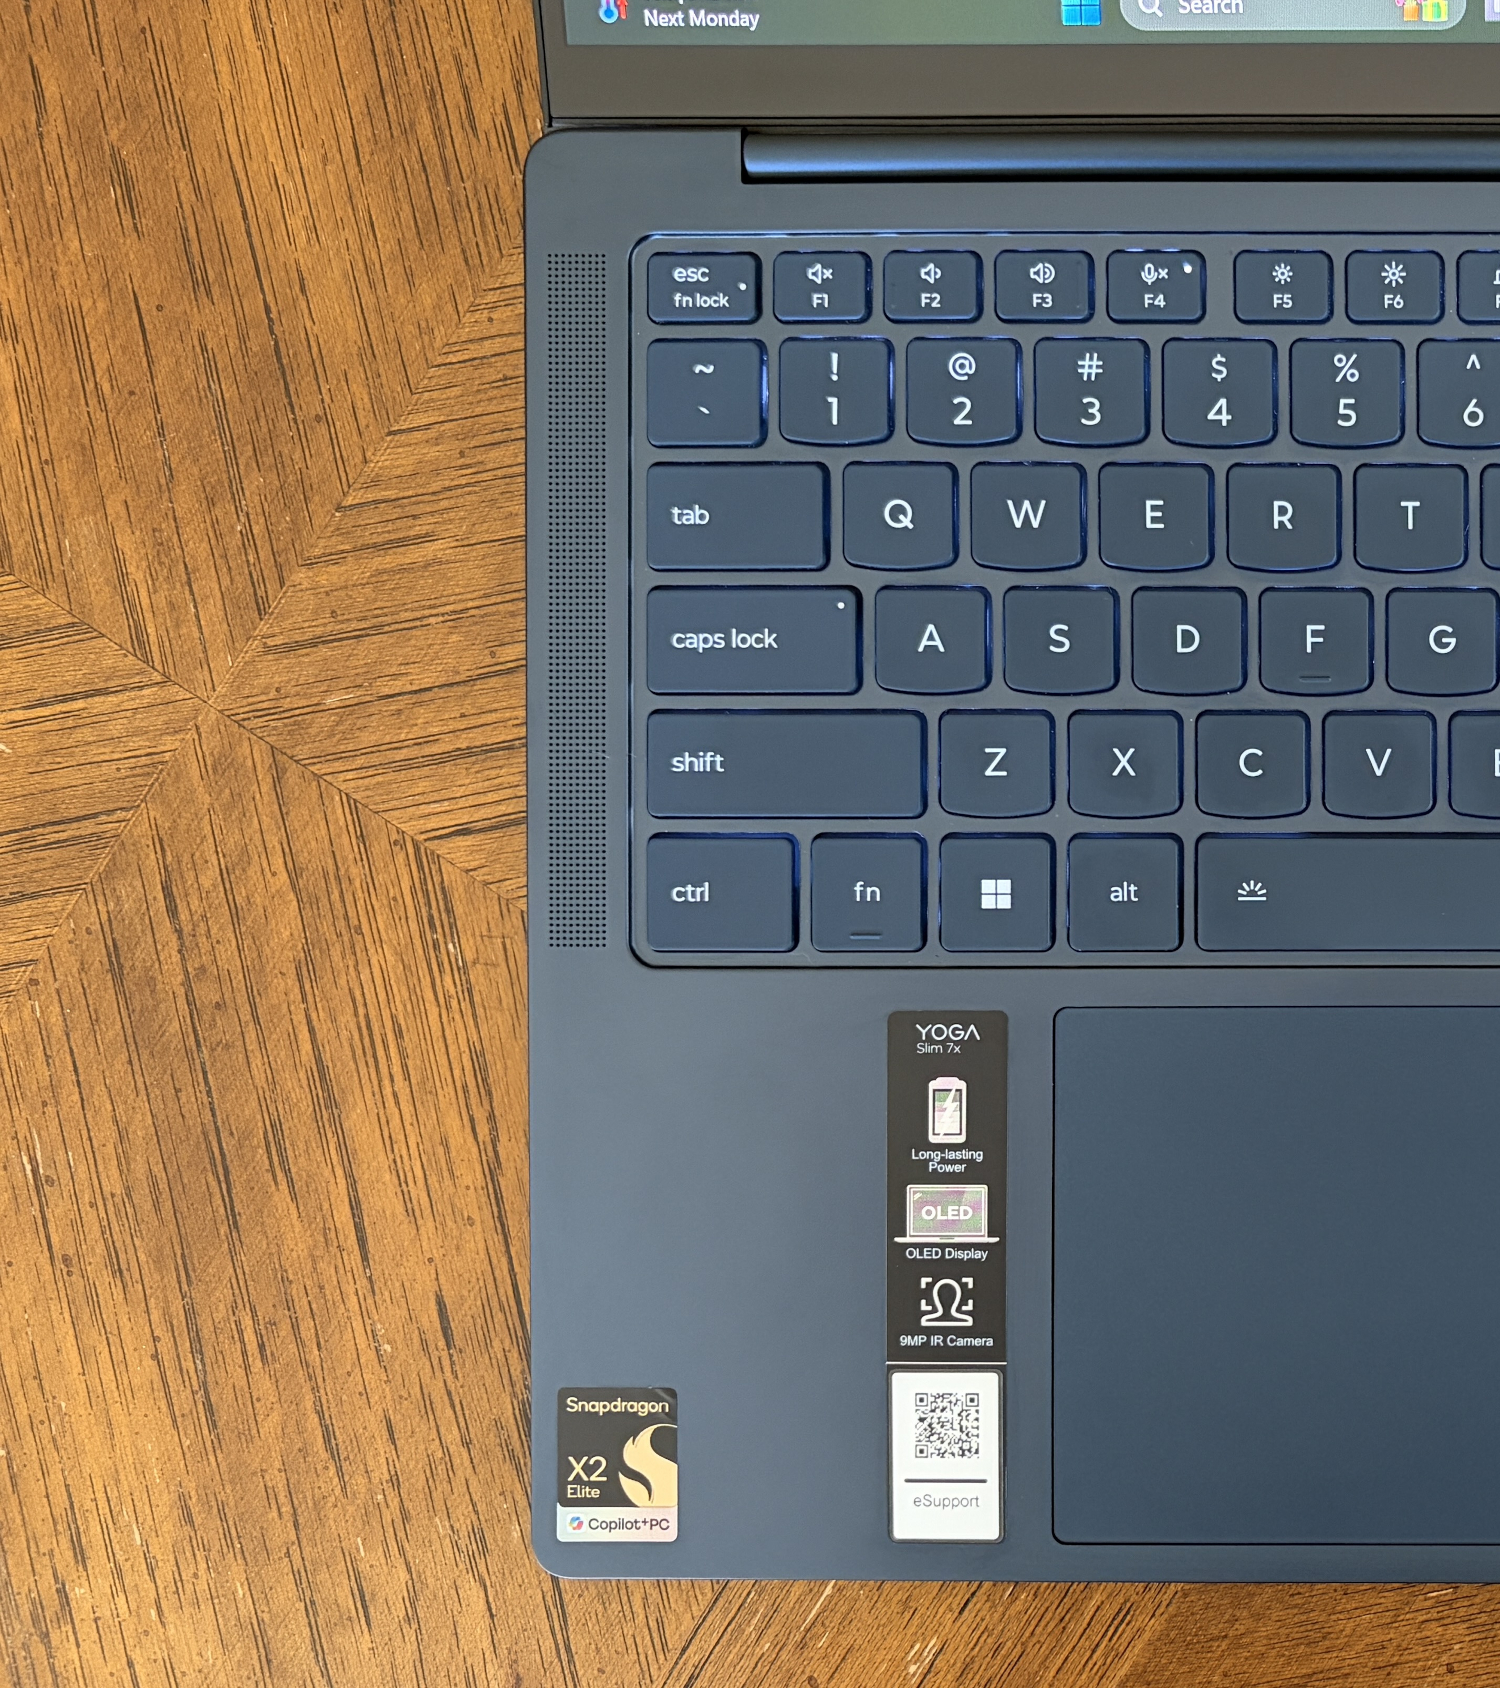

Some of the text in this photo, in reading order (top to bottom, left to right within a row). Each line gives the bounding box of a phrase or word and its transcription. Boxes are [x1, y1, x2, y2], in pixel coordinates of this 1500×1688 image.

[643, 8, 760, 32] Next Monday
[1178, 0, 1244, 14] Search
[672, 267, 710, 283] esc
[673, 292, 730, 308] fn lock
[811, 292, 829, 308] F1
[920, 292, 941, 308] F2
[1032, 292, 1053, 308] F3
[1144, 293, 1167, 309] F4
[1273, 293, 1293, 309] F5
[1383, 294, 1404, 309] F6
[693, 364, 715, 374] ~
[830, 352, 839, 382] !
[948, 351, 976, 381] @
[1077, 352, 1104, 382] #
[1211, 353, 1228, 382] $
[1333, 353, 1360, 383] %
[826, 396, 838, 426] 1
[952, 396, 973, 426] 2
[1080, 396, 1102, 426] 3
[1206, 397, 1232, 427] 4
[1337, 398, 1357, 427] 5
[1462, 398, 1484, 427] 6
[670, 504, 710, 525] tab
[883, 498, 914, 530] Q
[1006, 499, 1047, 529] W
[1145, 499, 1165, 529] E
[1273, 500, 1293, 530] R
[1400, 500, 1421, 530] T
[671, 627, 778, 654] caps lock
[917, 623, 945, 653] A
[1049, 623, 1071, 653] S
[1176, 624, 1200, 653] D
[1306, 624, 1326, 654] F
[1428, 624, 1457, 654] G
[670, 751, 725, 773] shift
[984, 747, 1008, 777] Z
[1111, 747, 1136, 777] X
[1238, 748, 1264, 777] C
[1365, 748, 1392, 777] V
[671, 881, 710, 903] ctrl
[853, 880, 881, 902] fn
[1109, 881, 1139, 902] alt
[914, 1023, 981, 1041] YOGA
[916, 1042, 961, 1054] Slim 7x
[911, 1148, 984, 1164] Long-lasting
[928, 1160, 967, 1173] Power
[921, 1205, 974, 1221] OLED
[905, 1247, 989, 1262] OLED Display
[899, 1334, 994, 1347] 9MP IR Camera
[566, 1396, 669, 1417] Snapdragon
[567, 1455, 608, 1482] X2
[566, 1484, 601, 1499] Elite
[913, 1493, 980, 1510] eSupport
